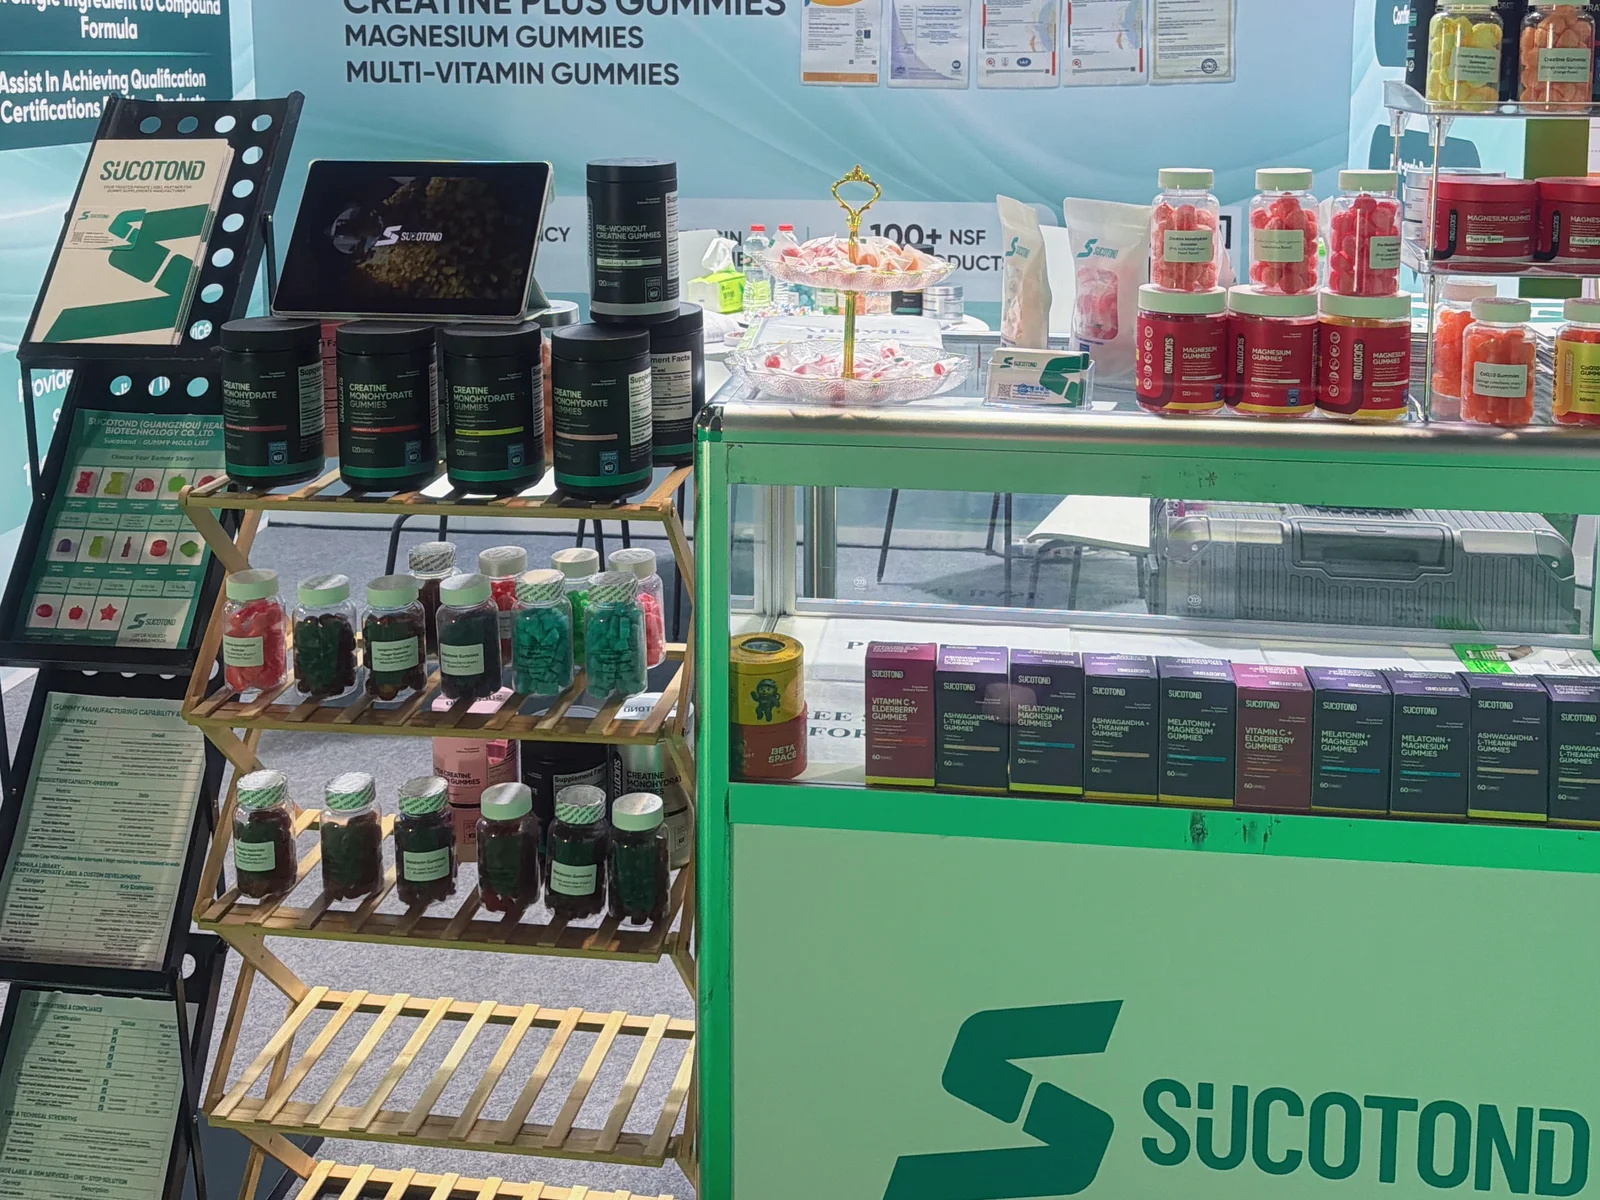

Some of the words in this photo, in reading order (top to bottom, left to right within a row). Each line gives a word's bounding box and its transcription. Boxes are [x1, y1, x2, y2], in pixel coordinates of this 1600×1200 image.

[80, 16, 138, 39] Formula
[344, 24, 509, 48] MAGNESIUM
[516, 25, 644, 49] GUMMIES
[346, 60, 544, 84] MULTI-VITAMIN
[552, 62, 680, 86] GUMMIES
[0, 70, 43, 94] Assist
[45, 69, 59, 93] In
[62, 68, 129, 95] Achieving
[131, 67, 207, 90] Qualification
[0, 98, 101, 124] Certifications
[100, 160, 206, 181] SUCOTOND
[596, 224, 648, 232] PRE-WORKOUT
[596, 231, 626, 240] CREATINE
[628, 231, 661, 240] GUMMIES
[870, 224, 942, 245] 100+
[950, 229, 986, 245] NSF
[672, 354, 691, 363] Facts
[1164, 338, 1174, 374] SUCOTOND
[1236, 337, 1245, 374] SUCOTOND
[1354, 343, 1364, 380] SUCOTOND
[224, 380, 250, 390] CREATINE
[349, 383, 388, 392] CREATINE
[453, 386, 488, 394] CREATINE
[224, 389, 278, 400] MONOHYDRATE
[349, 390, 413, 400] MONOHYDRATE
[454, 392, 515, 403] MONOHYDRATE
[554, 387, 582, 398] CREATINE
[350, 400, 388, 409] GUMMIES
[454, 402, 490, 412] GUMMIES
[554, 396, 608, 408] MONOHYDRATE
[88, 417, 138, 428] SUCOTOND
[140, 420, 201, 430] (GUANGZHOU)
[105, 427, 179, 436] BIOTECHNOLOGY
[872, 670, 904, 679] SUCOTOND
[1018, 675, 1051, 685] SUCOTOND
[944, 682, 976, 692] SUCOTOND
[1092, 686, 1126, 696] SUCOTOND
[1168, 690, 1202, 700] SUCOTOND
[872, 697, 902, 706] VITAMIN
[1245, 700, 1280, 710] SUCOTOND
[1478, 700, 1514, 710] SUCOTOND
[82, 706, 138, 716] MANUFACTURING
[872, 705, 918, 714] ELDERBERRY
[1018, 704, 1060, 714] MELATONIN
[1322, 702, 1358, 712] SUCOTOND
[1402, 706, 1438, 716] SUCOTOND
[872, 712, 908, 721] GUMMIES
[944, 712, 996, 721] ASHWAGANDHA
[1018, 711, 1062, 721] MAGNESIUM
[1560, 713, 1597, 722] SUCOTOND
[944, 718, 980, 727] L-THEANINE
[1018, 718, 1053, 728] GUMMIES
[1092, 717, 1146, 727] ASHWAGANDHA
[1168, 718, 1211, 728] MELATONIN
[944, 724, 974, 732] GUMMIES
[1092, 724, 1130, 732] L-THEANINE
[1168, 726, 1214, 736] MAGNESIUM
[1244, 726, 1279, 736] VITAMIN
[1280, 728, 1286, 736] C
[1092, 730, 1123, 738] GUMMIES
[1168, 732, 1204, 742] GUMMIES
[1244, 734, 1295, 744] ELDERBERRY
[1322, 730, 1366, 740] MELATONIN
[1402, 734, 1446, 744] MELATONIN
[1478, 732, 1534, 742] ASHWAGANDHA
[1321, 737, 1368, 746] MAGNESIUM
[1401, 742, 1449, 751] MAGNESIUM
[1478, 740, 1518, 748] L-THEANINE
[770, 744, 795, 754] BETA
[1244, 742, 1284, 752] GUMMIES
[1321, 744, 1358, 754] GUMMIES
[1478, 746, 1511, 754] GUMMIES
[768, 751, 797, 764] SPACE
[1401, 749, 1438, 758] GUMMIES
[444, 770, 472, 779] CREATINE
[626, 771, 664, 780] CREATINE
[1141, 1077, 1590, 1198] SUCOTOND
